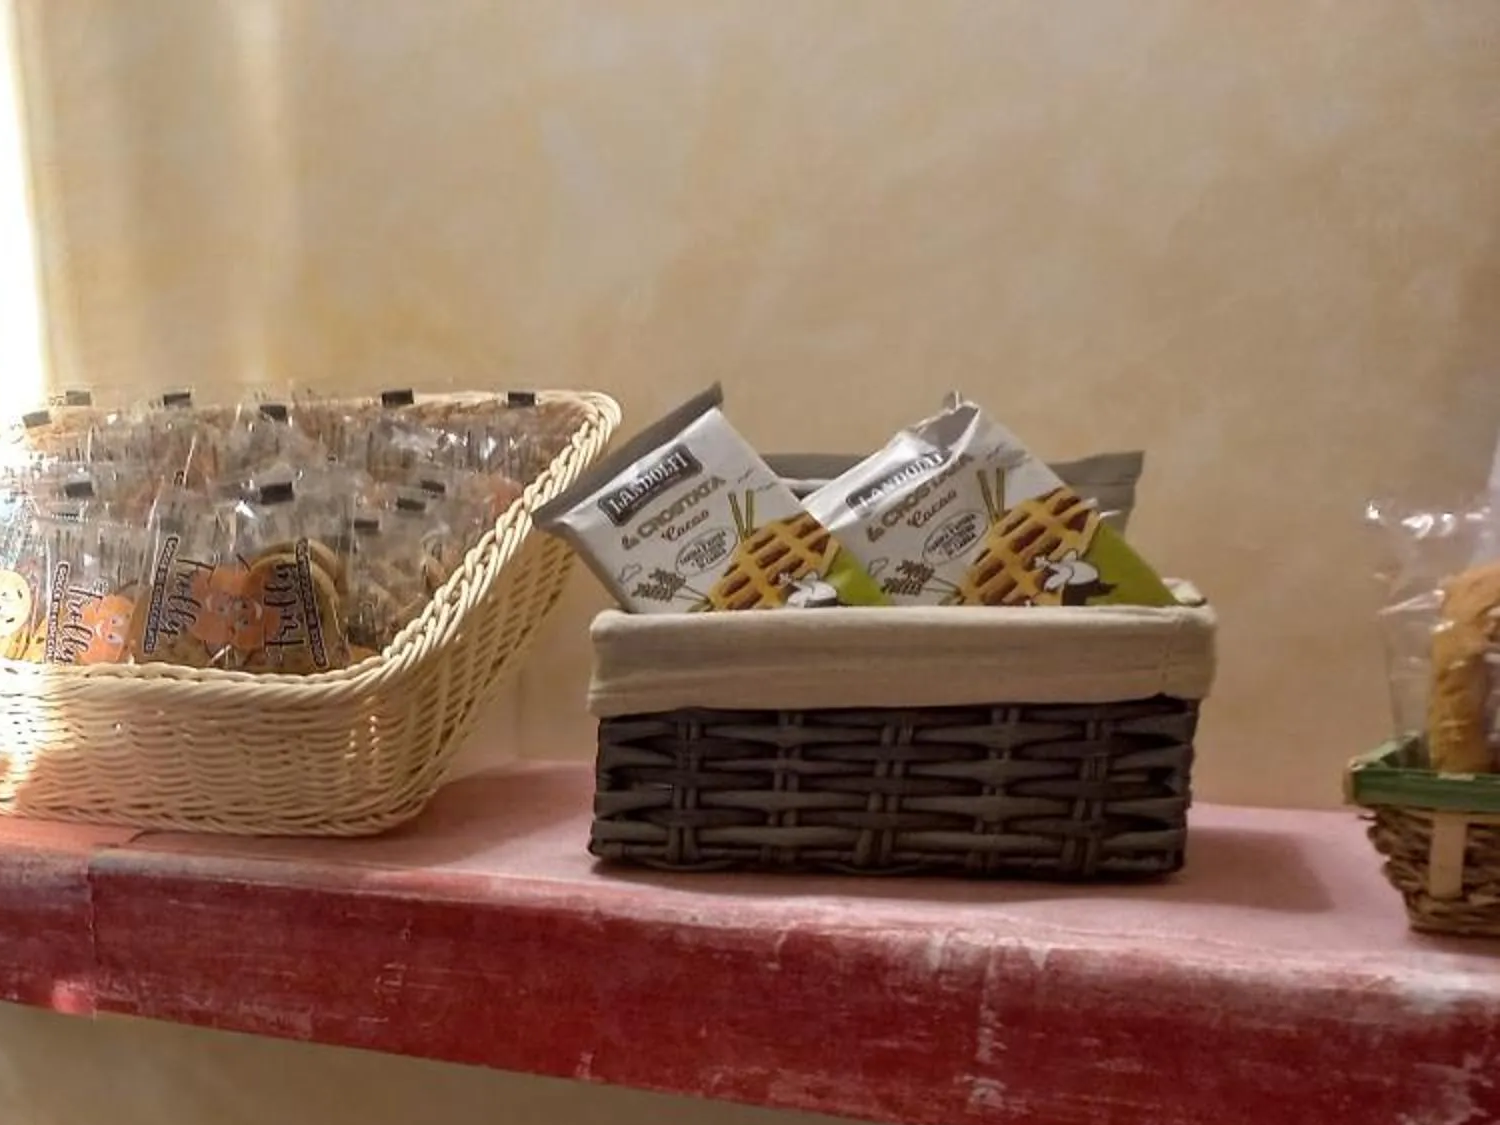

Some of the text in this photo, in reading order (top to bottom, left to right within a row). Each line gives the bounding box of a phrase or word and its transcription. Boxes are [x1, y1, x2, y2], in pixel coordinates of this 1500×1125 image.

[608, 451, 689, 514] LANDOLFI
[638, 476, 727, 539] CROSTATA
[661, 509, 710, 542] Cacao
